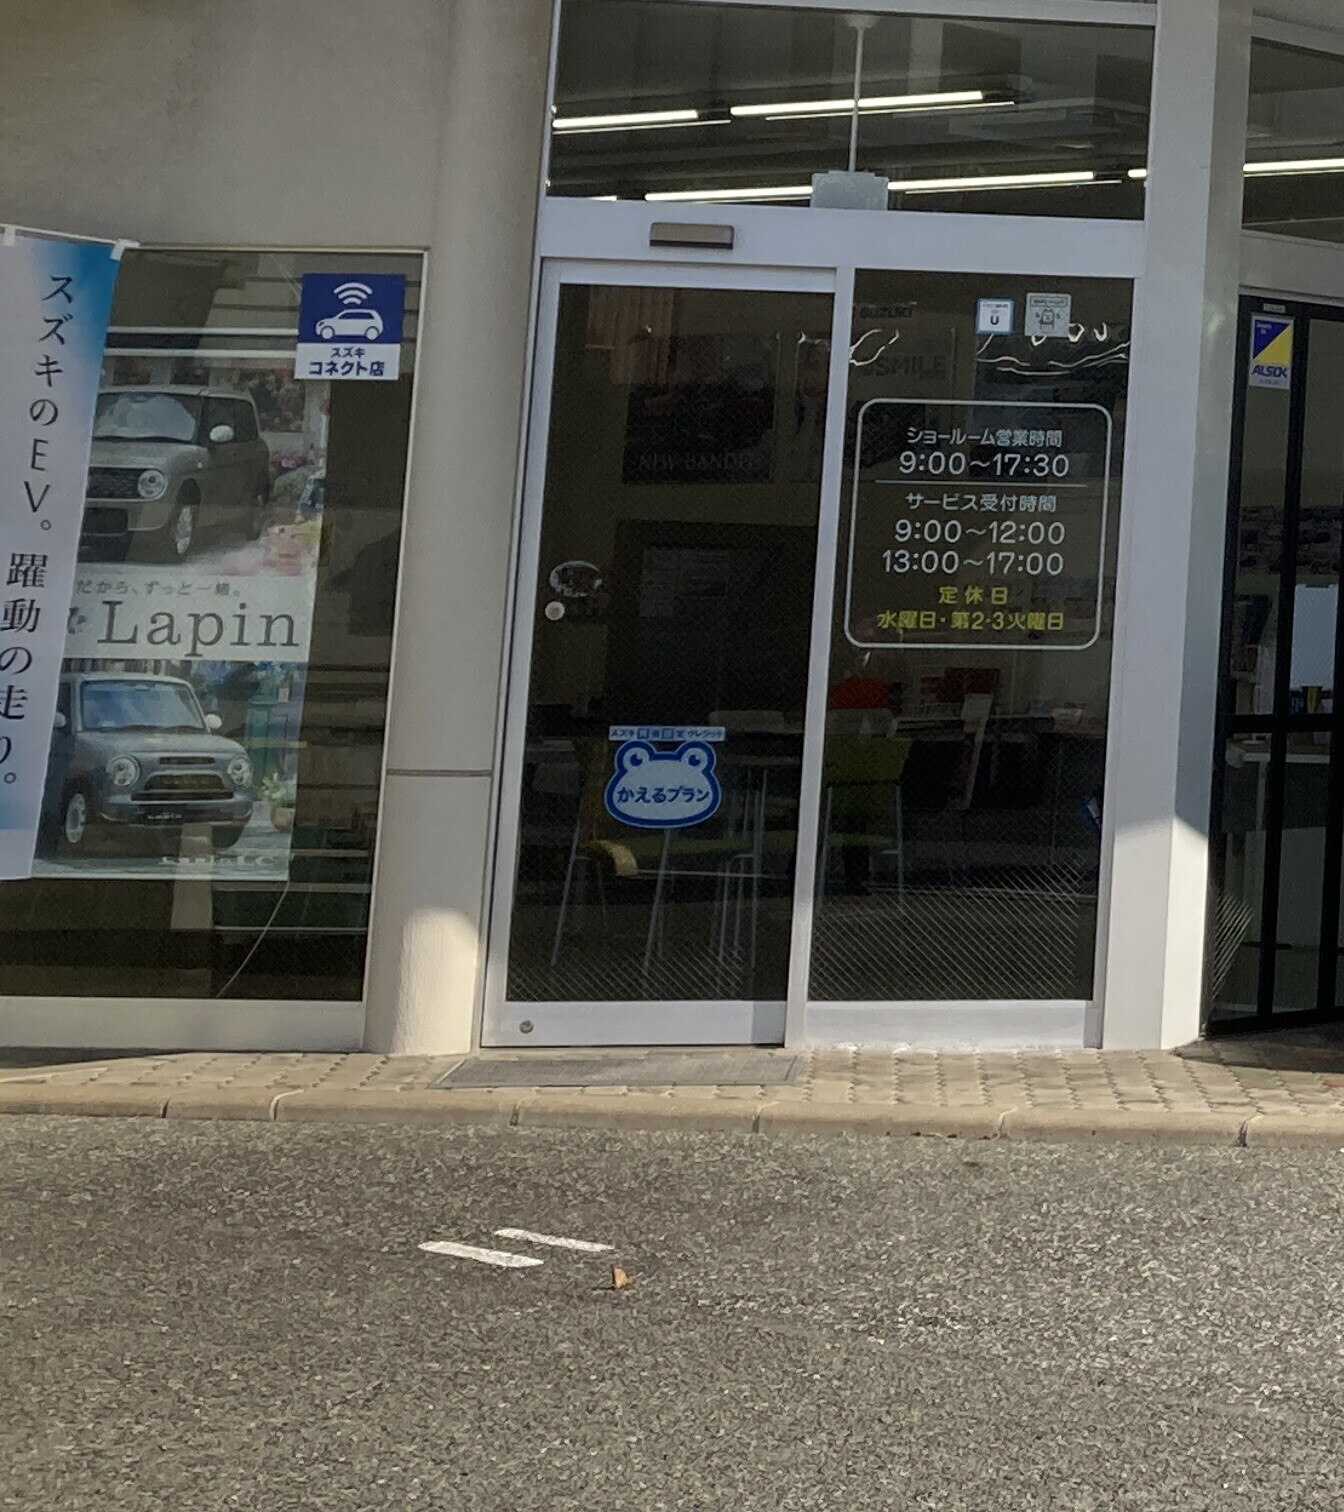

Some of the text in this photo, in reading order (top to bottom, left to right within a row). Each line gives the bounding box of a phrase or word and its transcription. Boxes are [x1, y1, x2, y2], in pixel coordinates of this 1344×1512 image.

[330, 346, 366, 359] スズキ
[308, 360, 385, 377] コネクト店
[906, 426, 1063, 448] ショールーム営業時間
[906, 492, 1057, 513] サービス受付時間
[938, 586, 1009, 605] 定休日
[97, 600, 300, 657] Lapin
[617, 786, 710, 803] かえるプラン
